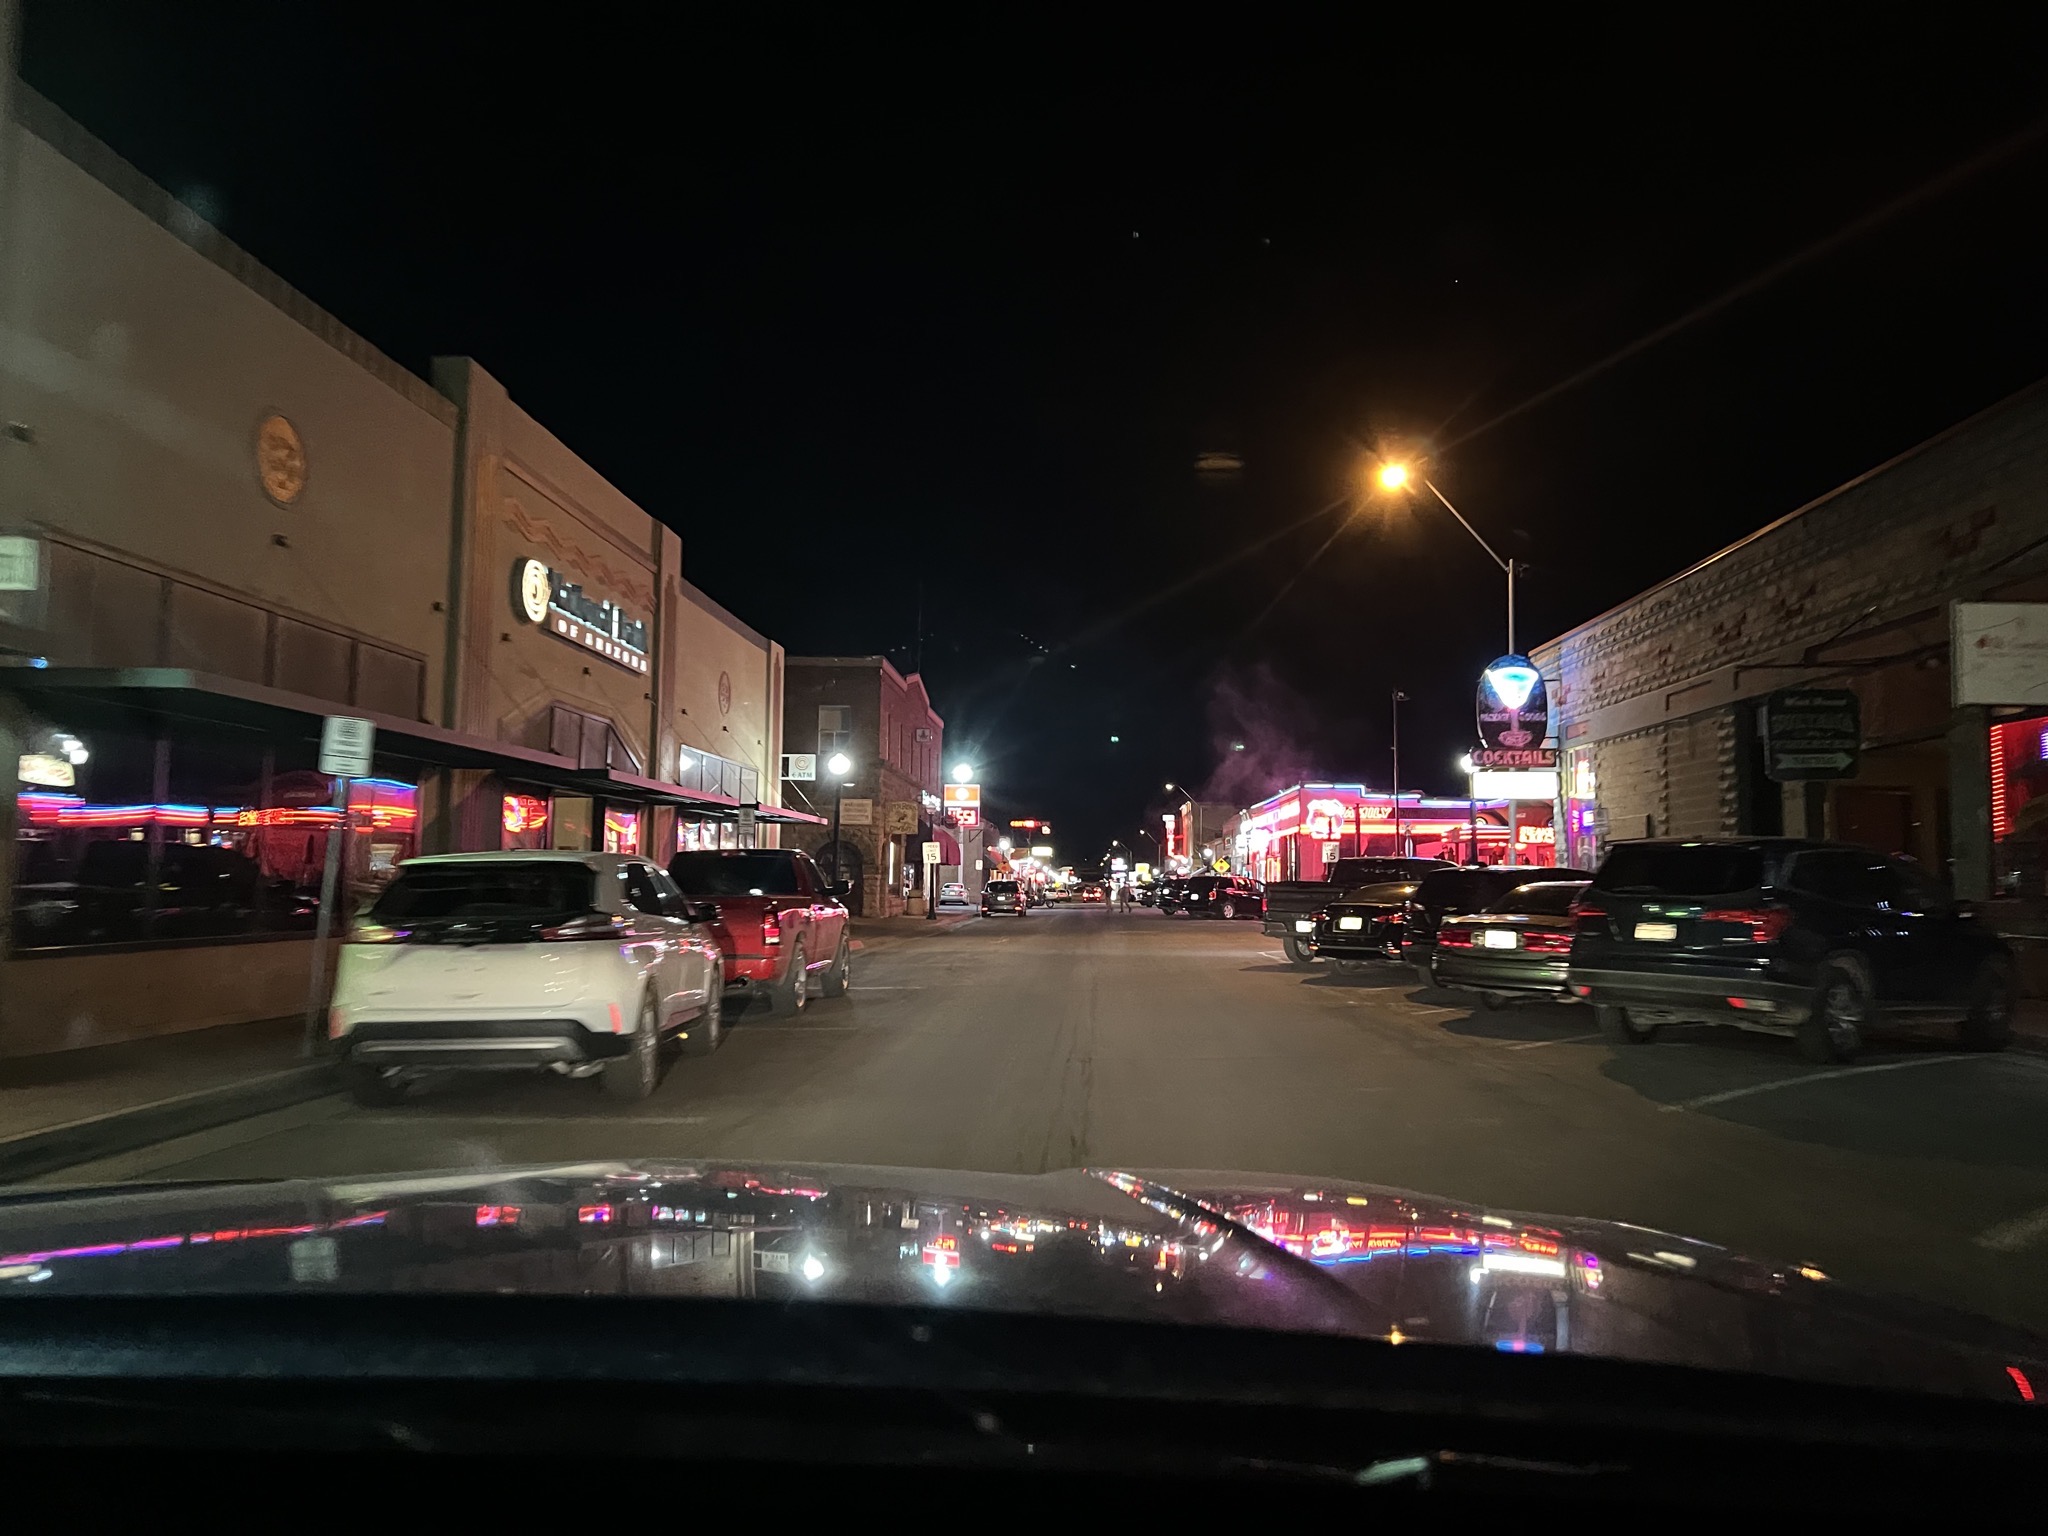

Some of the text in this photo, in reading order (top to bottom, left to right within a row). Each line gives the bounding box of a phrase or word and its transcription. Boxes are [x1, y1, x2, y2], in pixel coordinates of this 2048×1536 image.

[1473, 750, 1555, 765] COCKTAILS
[926, 853, 937, 861] 15
[1326, 852, 1336, 860] 15
